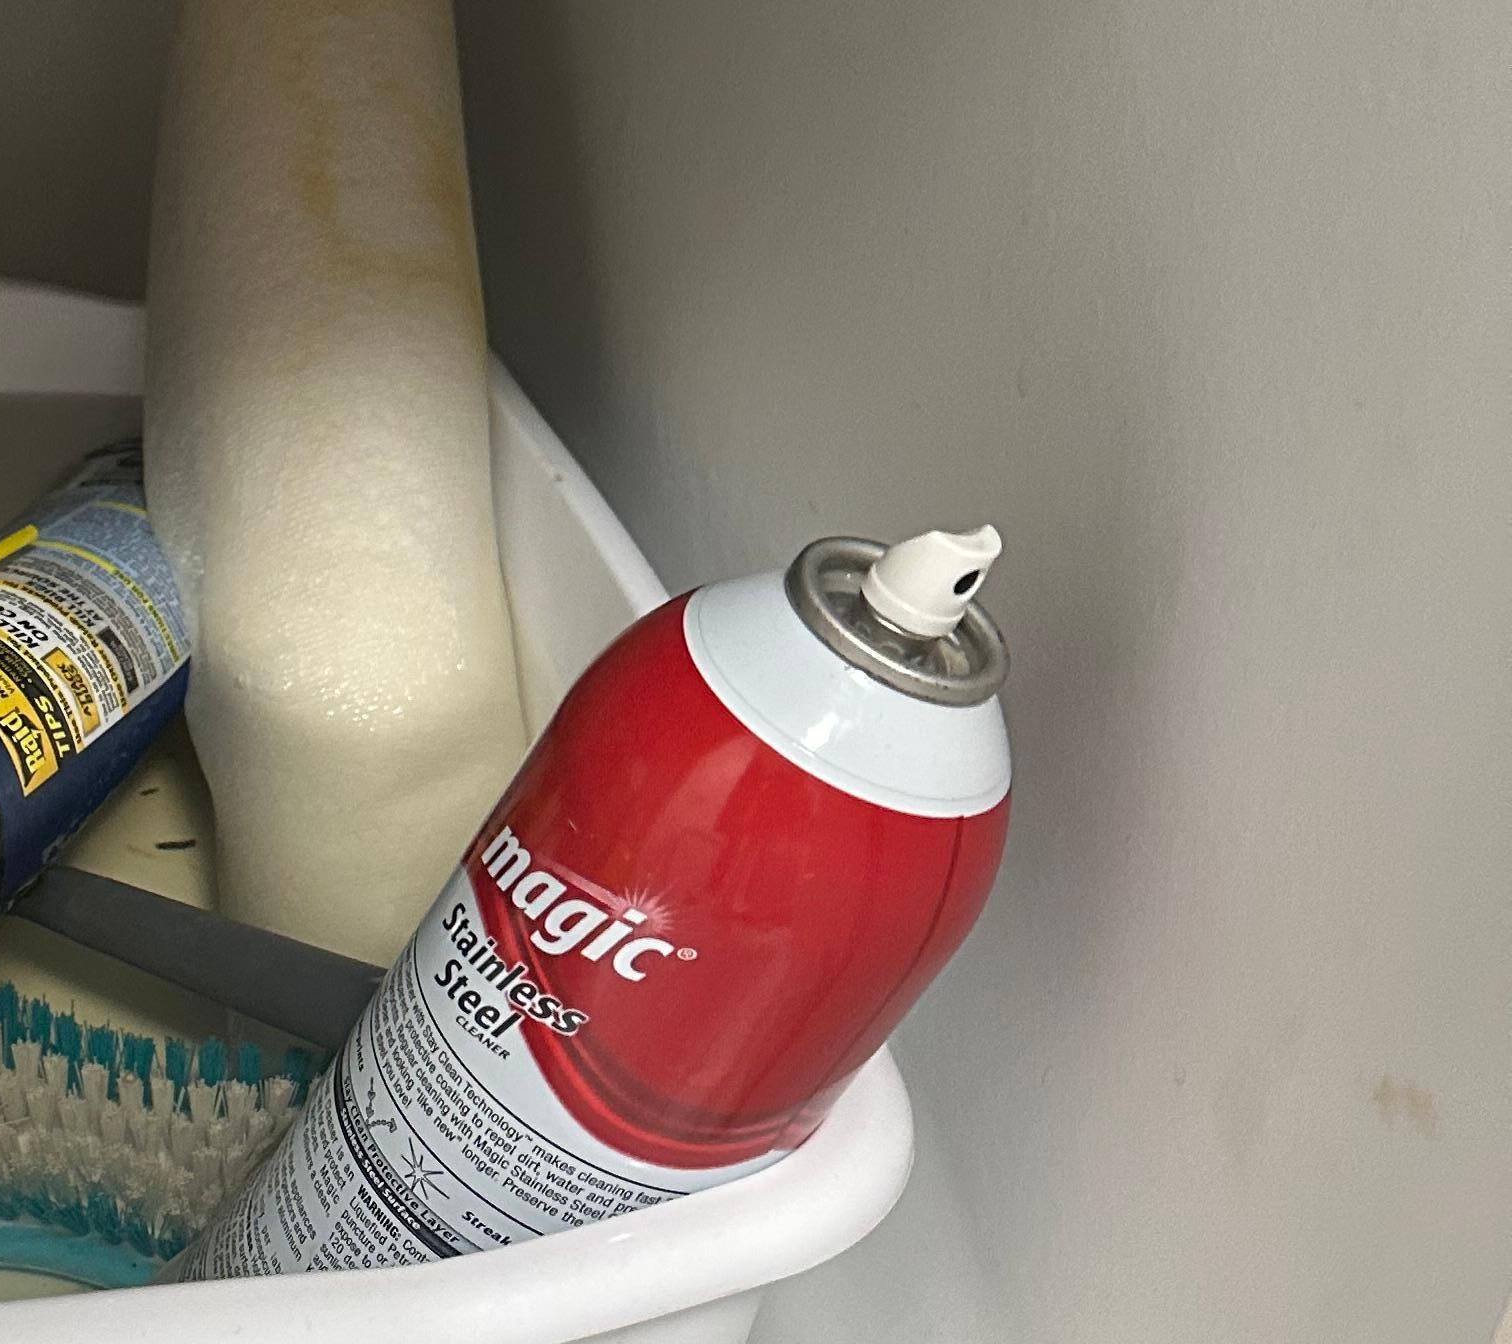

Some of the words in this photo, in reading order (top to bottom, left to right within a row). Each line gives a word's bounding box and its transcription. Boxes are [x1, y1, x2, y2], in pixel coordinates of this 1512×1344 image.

[17, 619, 50, 643] ON
[34, 694, 71, 758] TIPS
[480, 825, 676, 982] magic
[433, 958, 526, 1040] Steel
[442, 902, 589, 1037] Stainless
[455, 1014, 512, 1061] CLEANER
[390, 1046, 415, 1091] looking
[501, 1176, 560, 1218] Preserve
[561, 1210, 585, 1229] the
[396, 1024, 420, 1068] Regular
[415, 1067, 452, 1119] cleaning
[449, 1112, 474, 1139] with
[473, 1134, 511, 1171] Magic
[510, 1164, 570, 1207] Stainless
[569, 1201, 608, 1222] Steel
[404, 1019, 437, 1075] protective
[434, 1072, 472, 1119] coating
[471, 1112, 484, 1129] to
[483, 1125, 518, 1158] repel
[517, 1150, 542, 1177] dirt,
[546, 1169, 587, 1197] water
[585, 1189, 616, 1209] and
[422, 1025, 440, 1054] Stay
[437, 1050, 464, 1087] Clean
[531, 1143, 578, 1178] makes
[577, 1169, 634, 1202] cleaning
[319, 1163, 341, 1206] Magic
[323, 1149, 348, 1191] protect
[349, 1104, 369, 1144] Clean
[367, 1142, 421, 1212] Protective
[419, 1209, 462, 1245] Layer
[361, 1157, 386, 1189] Steel
[382, 1188, 424, 1231] Surface
[276, 1205, 303, 1263] aluminum
[289, 1178, 320, 1242] appliances
[292, 1223, 309, 1246] and
[334, 1221, 363, 1258] expose
[340, 1208, 378, 1254] puncture
[348, 1195, 390, 1247] Liquefied
[355, 1183, 404, 1243] WARNING:
[327, 1231, 346, 1256] 120
